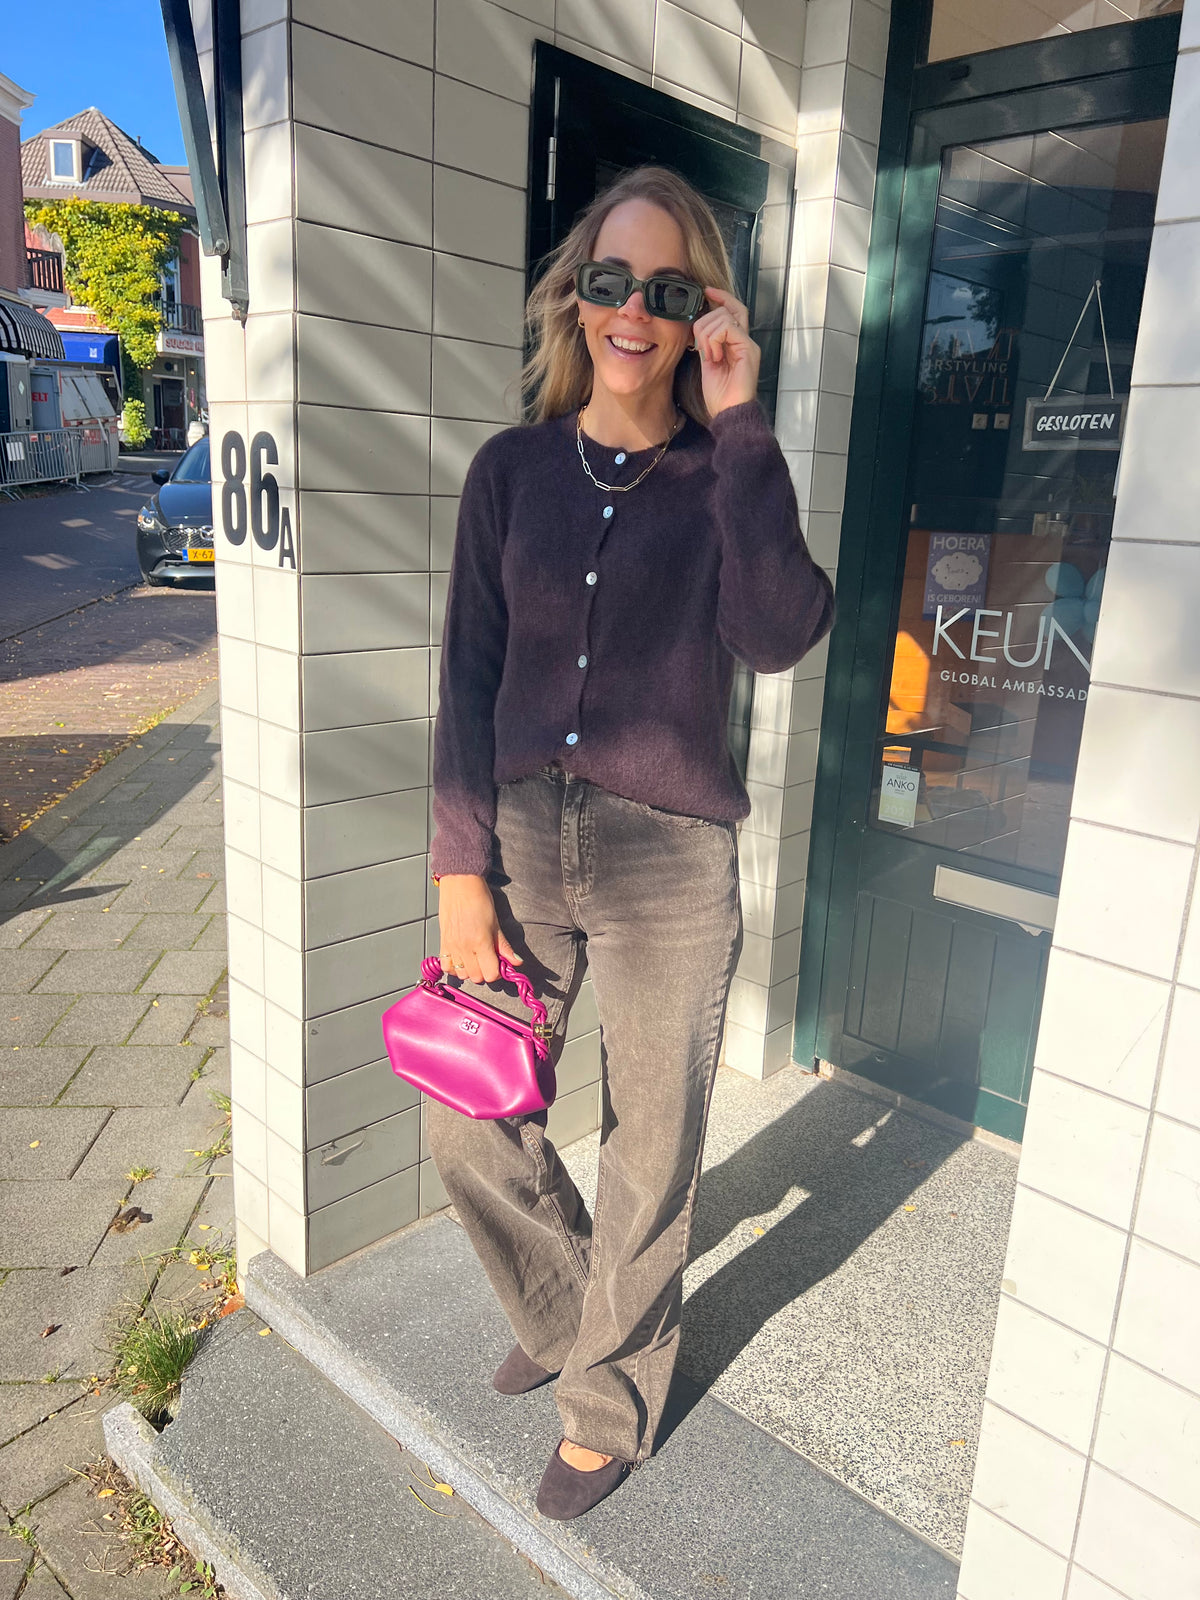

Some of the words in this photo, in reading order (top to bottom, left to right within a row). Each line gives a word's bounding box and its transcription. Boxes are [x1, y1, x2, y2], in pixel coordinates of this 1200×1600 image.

[1036, 413, 1115, 432] GESLOTEN
[932, 536, 985, 551] HOERA
[927, 593, 936, 602] IS
[936, 594, 982, 604] GEBOREN!
[940, 670, 997, 689] GLOBAL
[1002, 679, 1088, 702] AMBASSAD
[886, 778, 916, 792] ANKO
